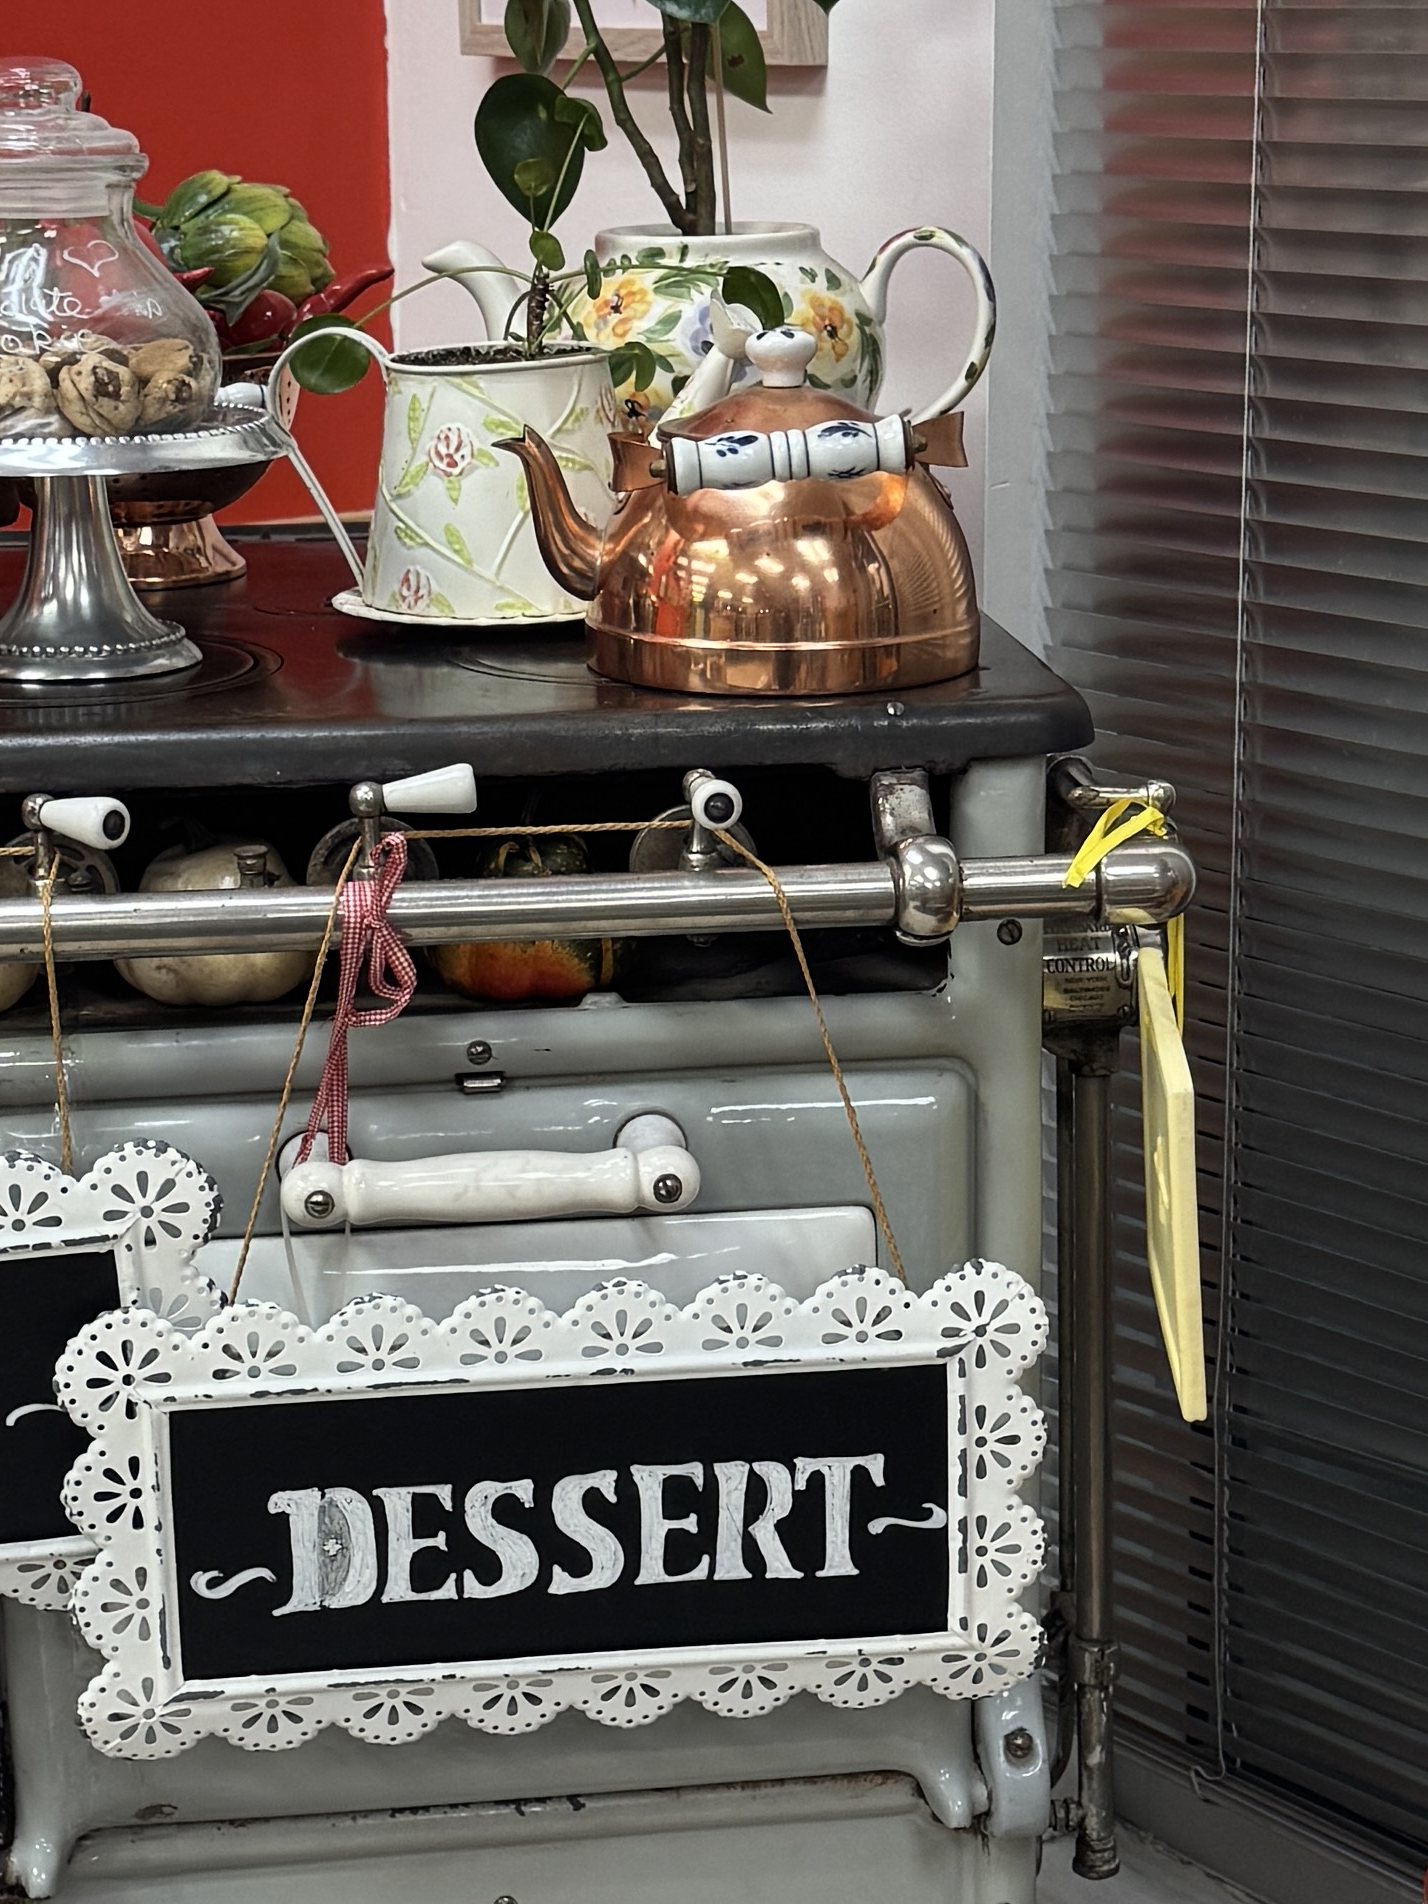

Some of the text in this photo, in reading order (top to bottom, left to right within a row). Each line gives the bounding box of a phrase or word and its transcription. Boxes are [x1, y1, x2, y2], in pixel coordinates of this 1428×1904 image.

[1056, 937, 1101, 952] HEAT
[1045, 956, 1116, 974] CONTROL
[268, 1453, 886, 1617] DESSERT
